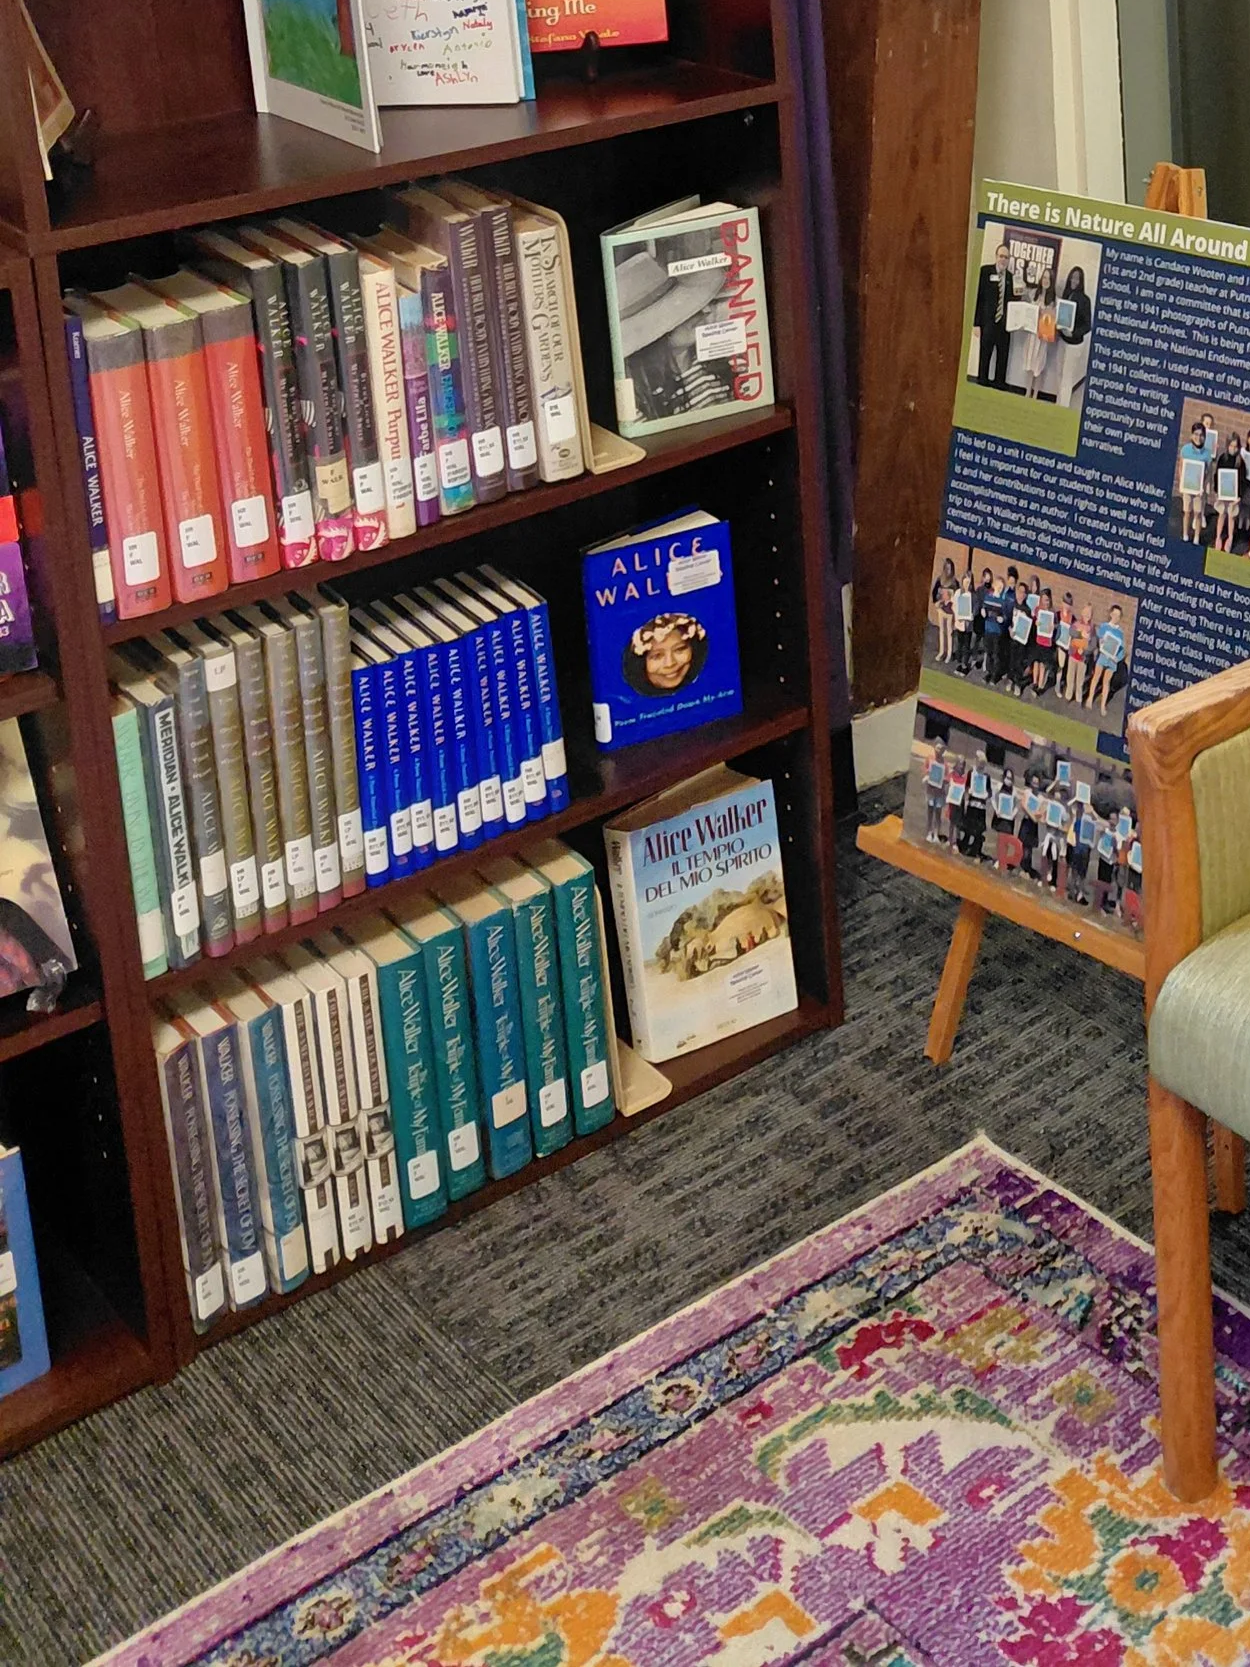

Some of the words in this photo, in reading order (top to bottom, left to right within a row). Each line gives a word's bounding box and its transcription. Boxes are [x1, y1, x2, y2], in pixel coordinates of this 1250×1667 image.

[987, 192, 1040, 219] There
[1046, 202, 1061, 223] is
[1065, 207, 1135, 239] Nature
[1138, 221, 1168, 245] All
[1171, 228, 1248, 262] Around
[671, 261, 695, 273] Alice
[697, 255, 729, 271] Walker
[1009, 239, 1055, 265] TOGETHER
[1106, 247, 1119, 261] My
[1120, 251, 1144, 264] name
[1146, 255, 1152, 266] is
[1154, 258, 1190, 274] Candace
[1192, 265, 1226, 282] Wooten
[1227, 273, 1244, 286] and
[1103, 263, 1119, 276] (1st
[1121, 267, 1137, 279] and
[1138, 270, 1154, 283] 2nd
[1156, 275, 1184, 290] grade)
[1185, 280, 1217, 297] teacher
[1219, 289, 1228, 299] at
[375, 282, 393, 331] ALICE
[226, 361, 239, 390] Alice
[379, 331, 399, 403] WALKER
[119, 389, 131, 420] Alice
[230, 388, 243, 430] Walker
[81, 435, 97, 472] ALICE
[122, 419, 135, 460] Walker
[87, 473, 104, 528] WALKER
[612, 537, 706, 577] ALICE
[595, 576, 661, 607] WAL
[512, 619, 524, 657] ALICE
[533, 613, 546, 651] ALICE
[359, 676, 371, 714] ALICE
[517, 659, 531, 711] WALKER
[537, 653, 551, 704] WALKER
[158, 711, 178, 785] MERIDIAN
[362, 719, 376, 772] WALKER
[167, 794, 185, 838] ALICE
[643, 829, 692, 867] Alice
[695, 798, 768, 846] Walker
[172, 839, 194, 890] WALK
[645, 882, 677, 903] DEL
[680, 867, 713, 891] MIO
[716, 843, 772, 878] SPIRITO
[672, 860, 686, 878] IL
[687, 837, 745, 870] TEMPIO
[571, 886, 587, 921] Alice
[575, 920, 592, 968] Walker
[398, 969, 414, 1007] Alice
[402, 1005, 419, 1055] Walker
